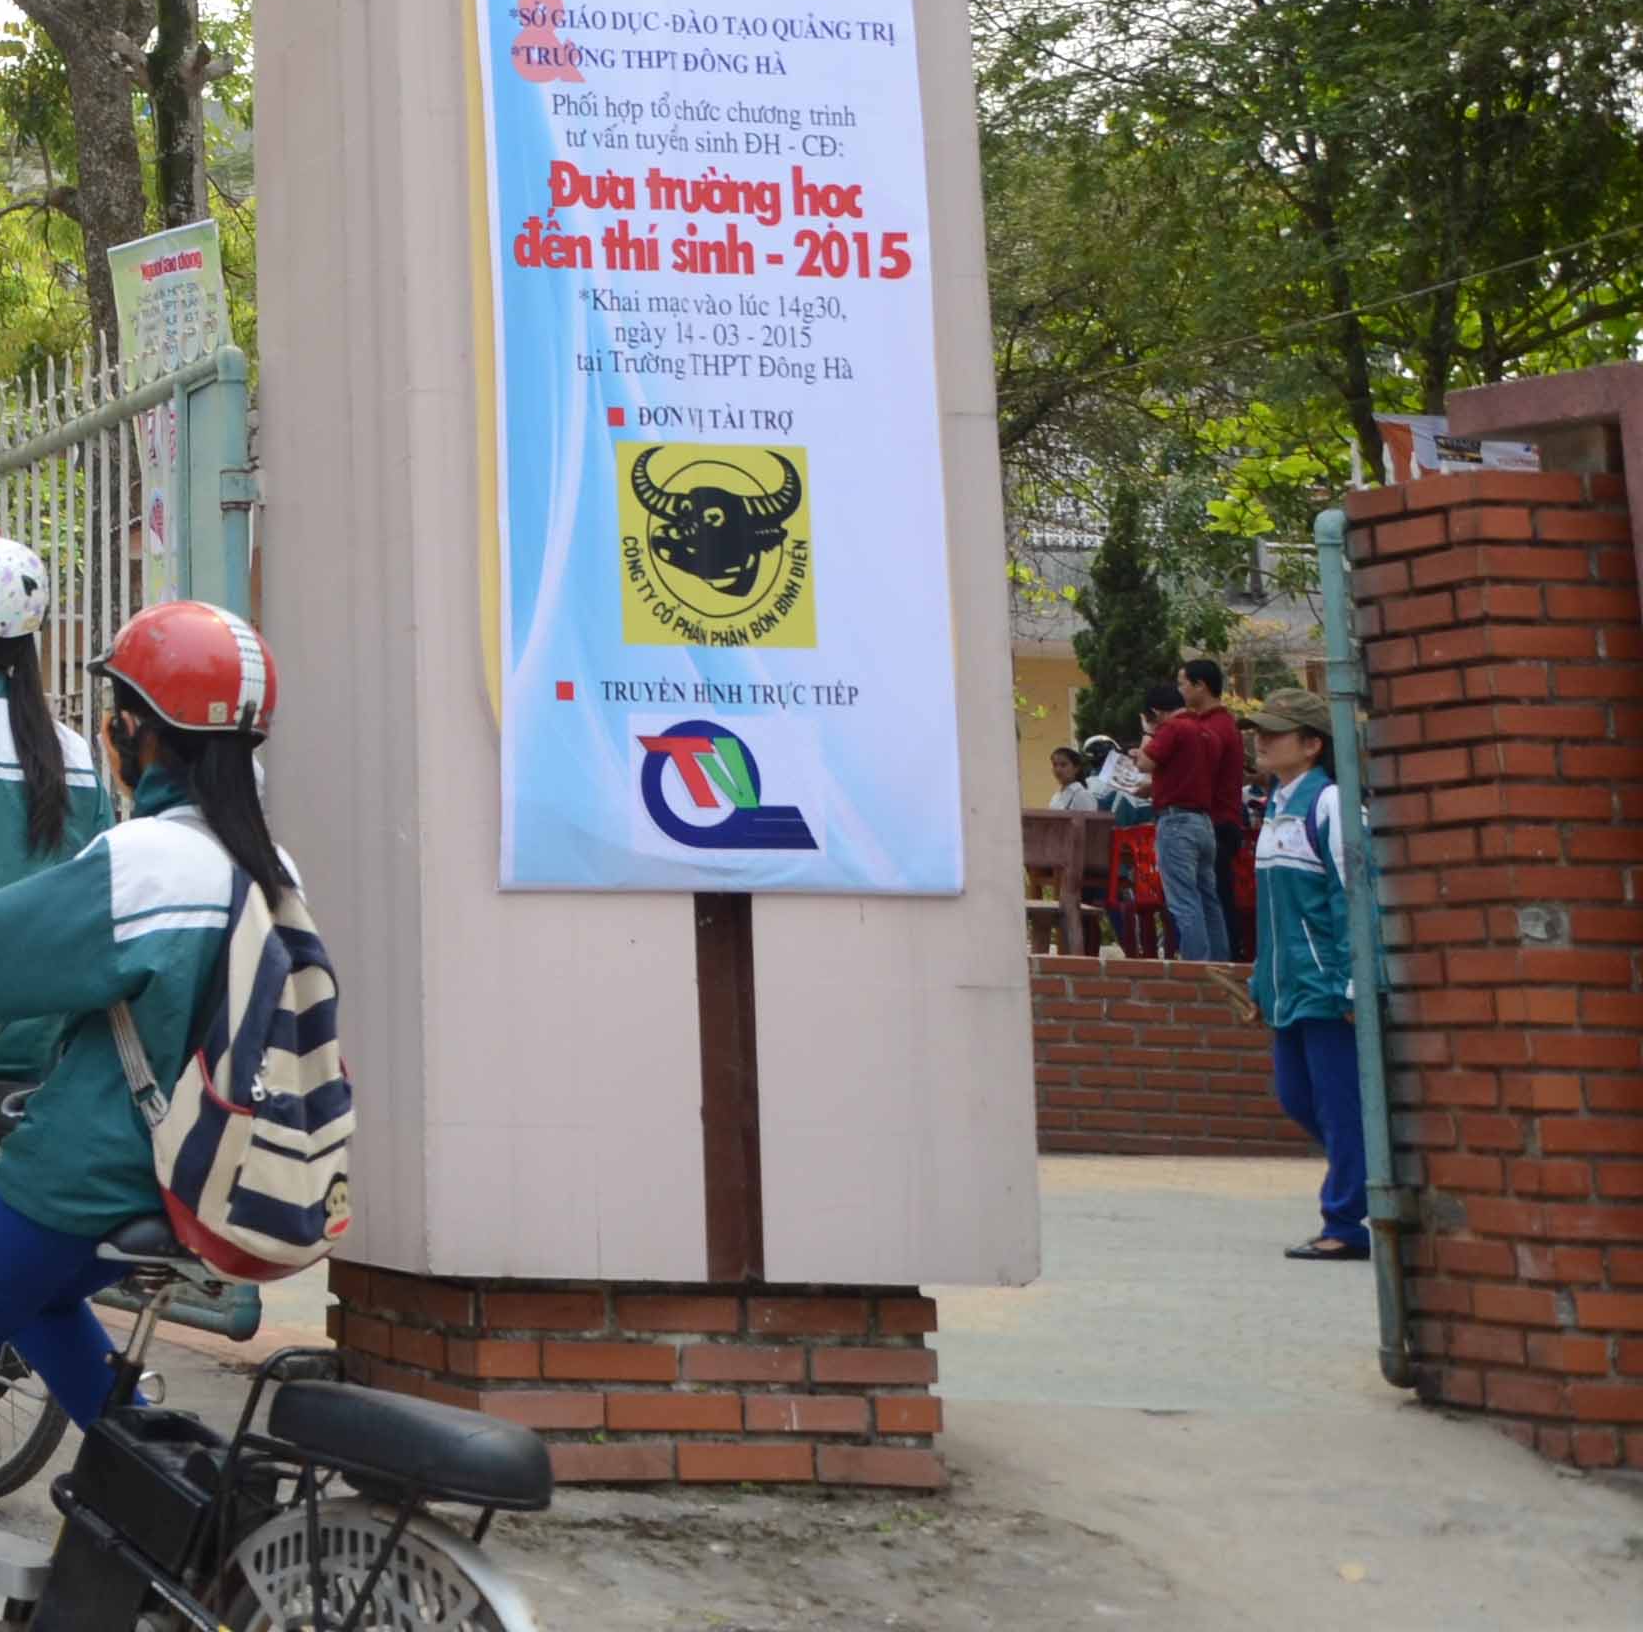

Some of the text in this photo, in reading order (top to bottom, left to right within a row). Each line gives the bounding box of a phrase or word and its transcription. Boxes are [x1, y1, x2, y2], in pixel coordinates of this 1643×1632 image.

[622, 50, 677, 70] THPT
[683, 48, 747, 73] ĐÔNG
[757, 52, 786, 75] HÀ
[548, 160, 863, 229] Đưa trường học
[514, 207, 592, 269] đến
[601, 219, 660, 272] thí
[671, 221, 755, 275] sinh
[794, 229, 912, 280] 2015
